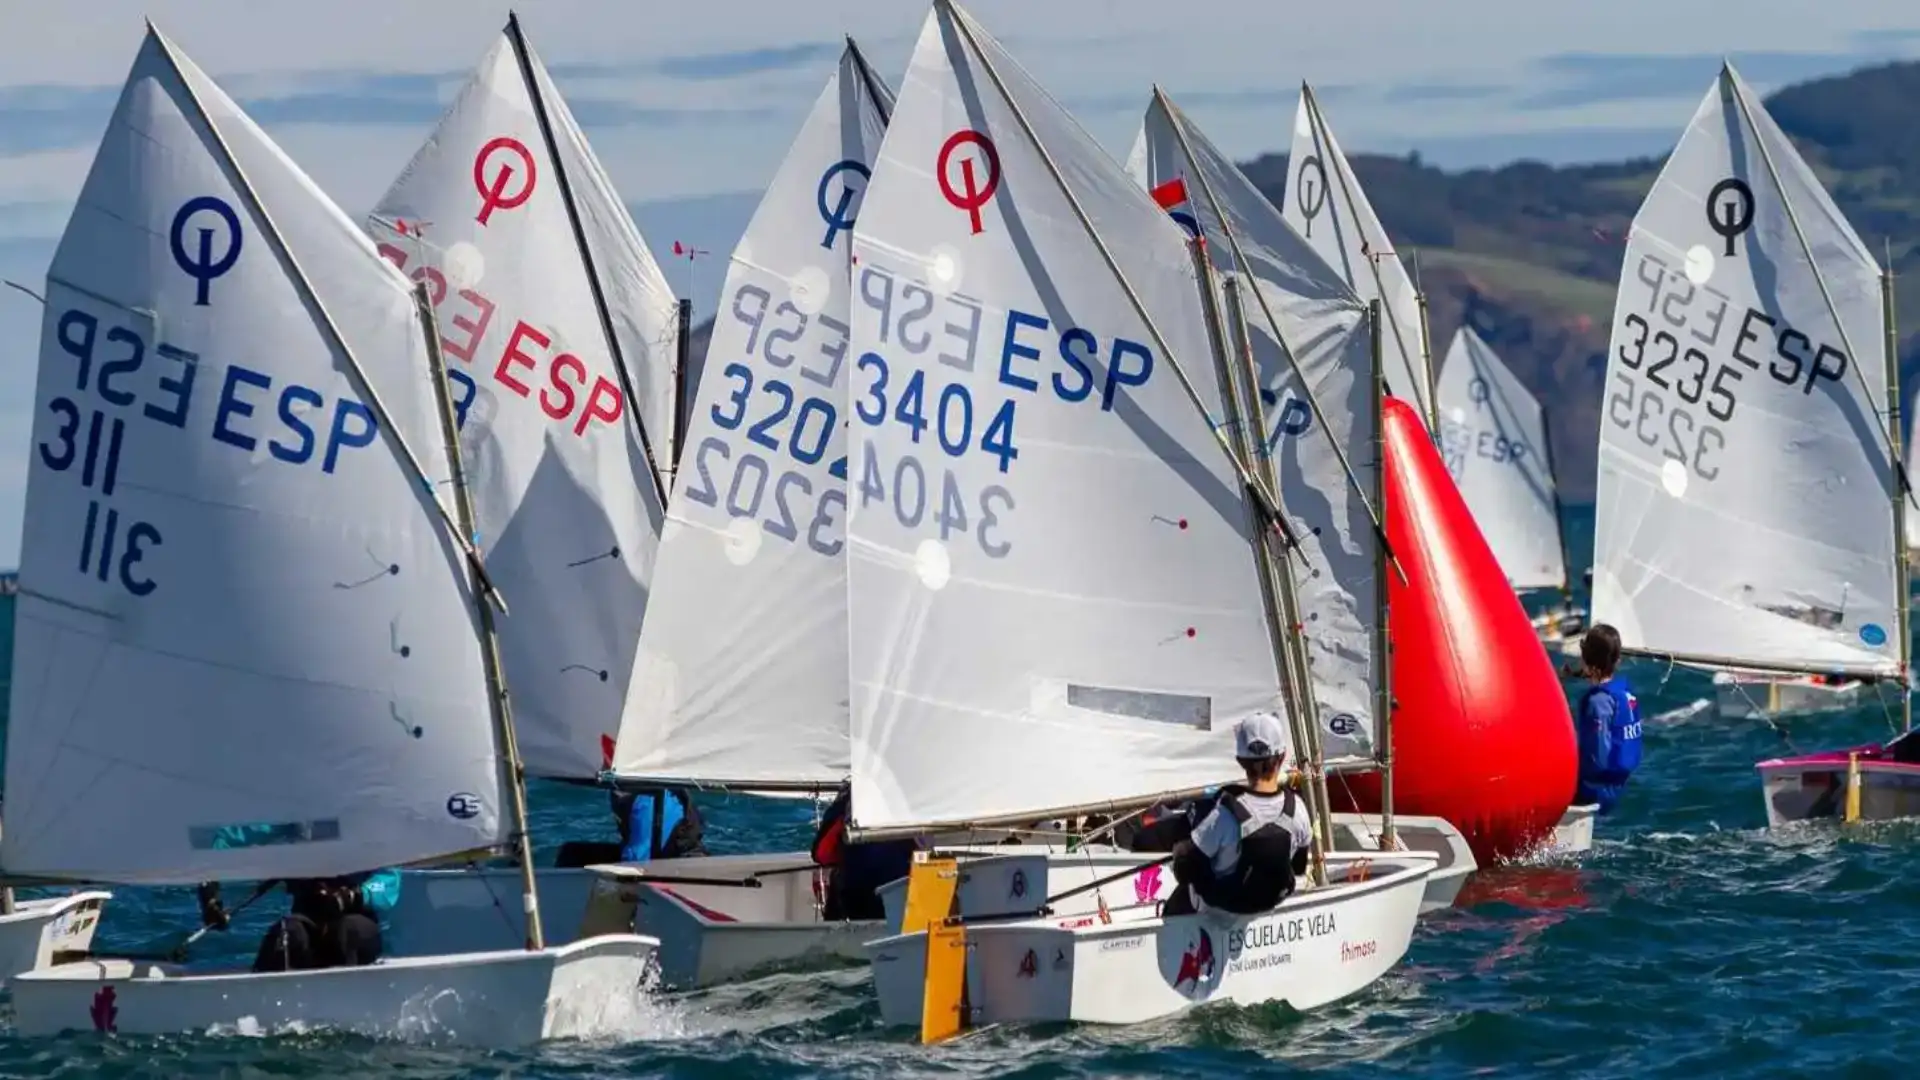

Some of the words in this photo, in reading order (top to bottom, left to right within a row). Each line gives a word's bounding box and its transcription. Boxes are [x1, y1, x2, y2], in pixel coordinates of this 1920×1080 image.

[494, 320, 623, 437] ESP
[999, 310, 1153, 412] ESP
[1619, 313, 1742, 422] 3235
[1732, 308, 1847, 395] ESP
[39, 397, 124, 495] 311
[212, 365, 378, 473] ESP
[856, 353, 1018, 473] 3404
[1477, 431, 1525, 464] ESP
[1228, 921, 1287, 952] ESCUELA
[1288, 918, 1304, 942] DE
[1308, 912, 1337, 937] VELA
